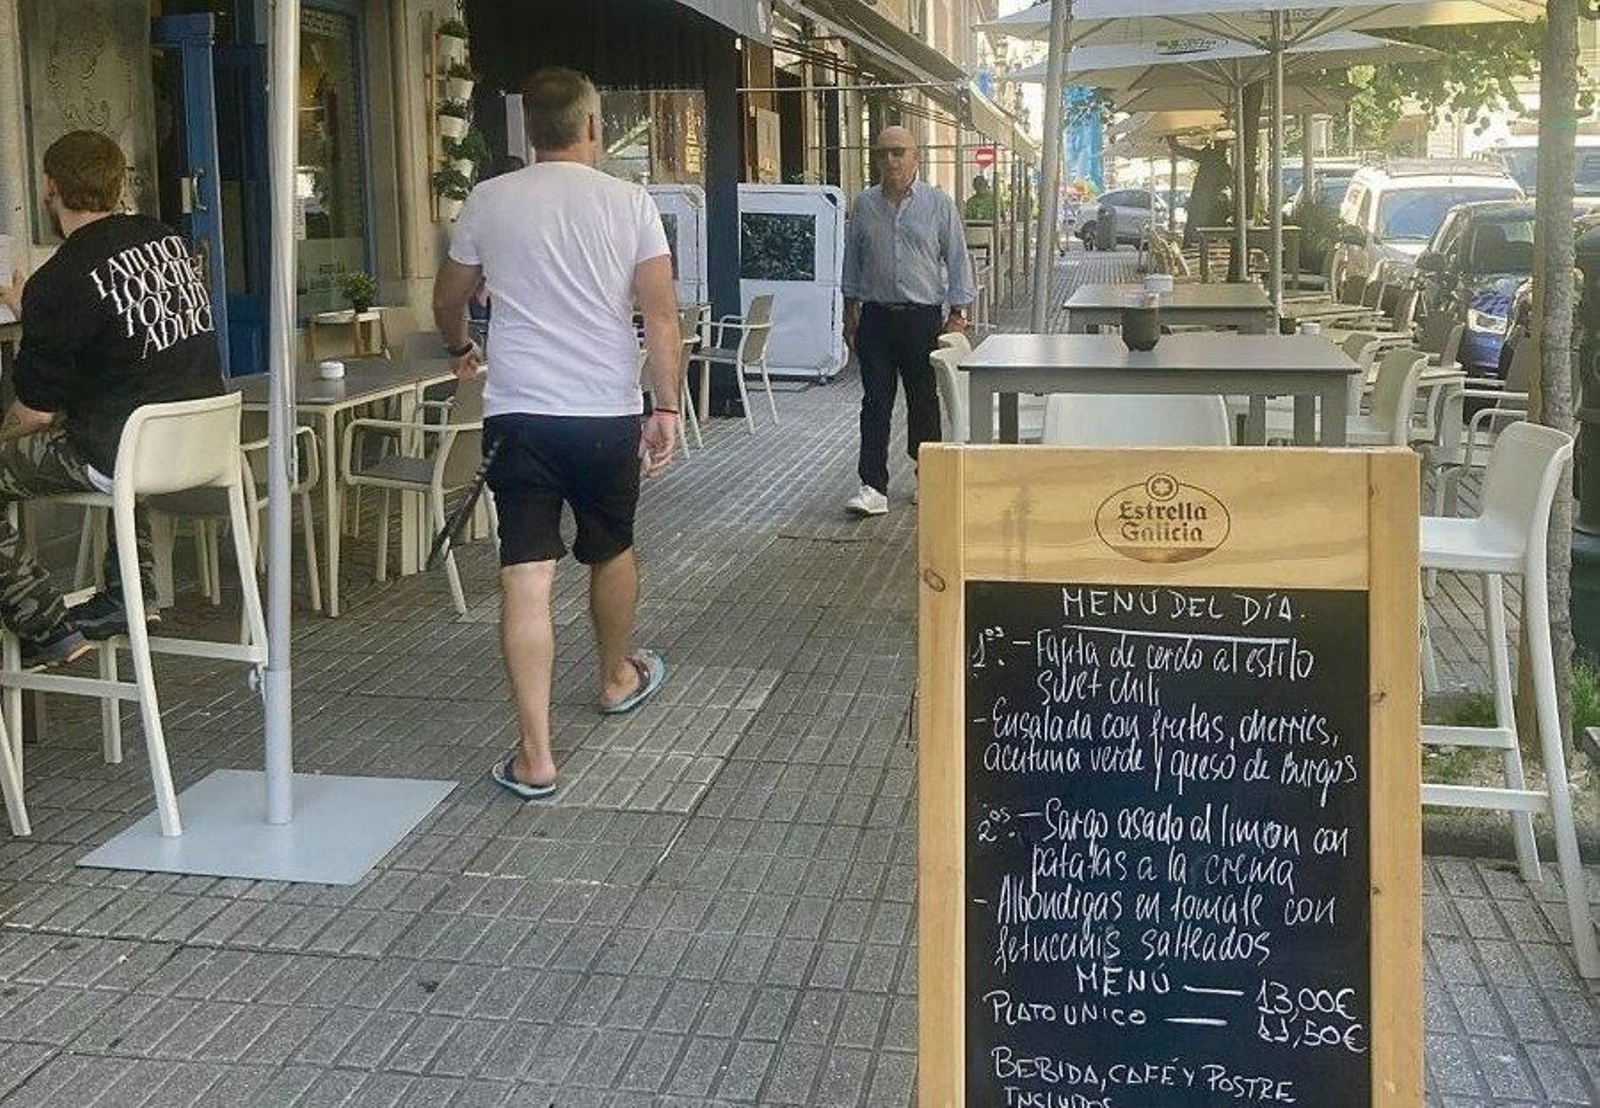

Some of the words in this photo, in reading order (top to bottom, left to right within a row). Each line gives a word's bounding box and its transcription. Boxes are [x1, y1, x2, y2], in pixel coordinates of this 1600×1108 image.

[1118, 500, 1208, 520] Estrella
[1121, 520, 1203, 542] Galicia
[1167, 590, 1224, 619] DEL
[1110, 634, 1136, 670] de
[1146, 638, 1203, 671] cerdo
[1213, 640, 1239, 674] al
[1245, 637, 1315, 681] estilo
[992, 696, 1094, 743] Ensalada
[1101, 712, 1141, 741] con
[983, 738, 1081, 775] aceituna
[1090, 737, 1146, 773] verde
[1170, 749, 1237, 796] queso
[1243, 748, 1271, 782] de
[1279, 751, 1358, 808] Burgos
[1042, 797, 1109, 860] Sargo
[1117, 803, 1184, 845] asado
[1189, 803, 1212, 845] al
[1312, 827, 1349, 858] con
[1030, 842, 1129, 895] patatas
[1136, 856, 1158, 882] a
[1167, 845, 1187, 885] la
[1205, 852, 1295, 896] crema
[1135, 892, 1162, 924] en
[1169, 885, 1263, 927] tomate
[1284, 896, 1336, 926] con
[1141, 920, 1271, 967] salteados
[1075, 963, 1172, 997] MENÚ
[1256, 978, 1358, 1023] 13,00€
[981, 989, 1057, 1026] PLATO
[1063, 1001, 1147, 1027] UNICO
[1257, 1013, 1368, 1054] 11,50€
[990, 1045, 1107, 1093] BEBIDA,
[1108, 1056, 1180, 1086] CAFÉ
[1183, 1066, 1196, 1087] Y
[1200, 1063, 1297, 1103] POSTRE
